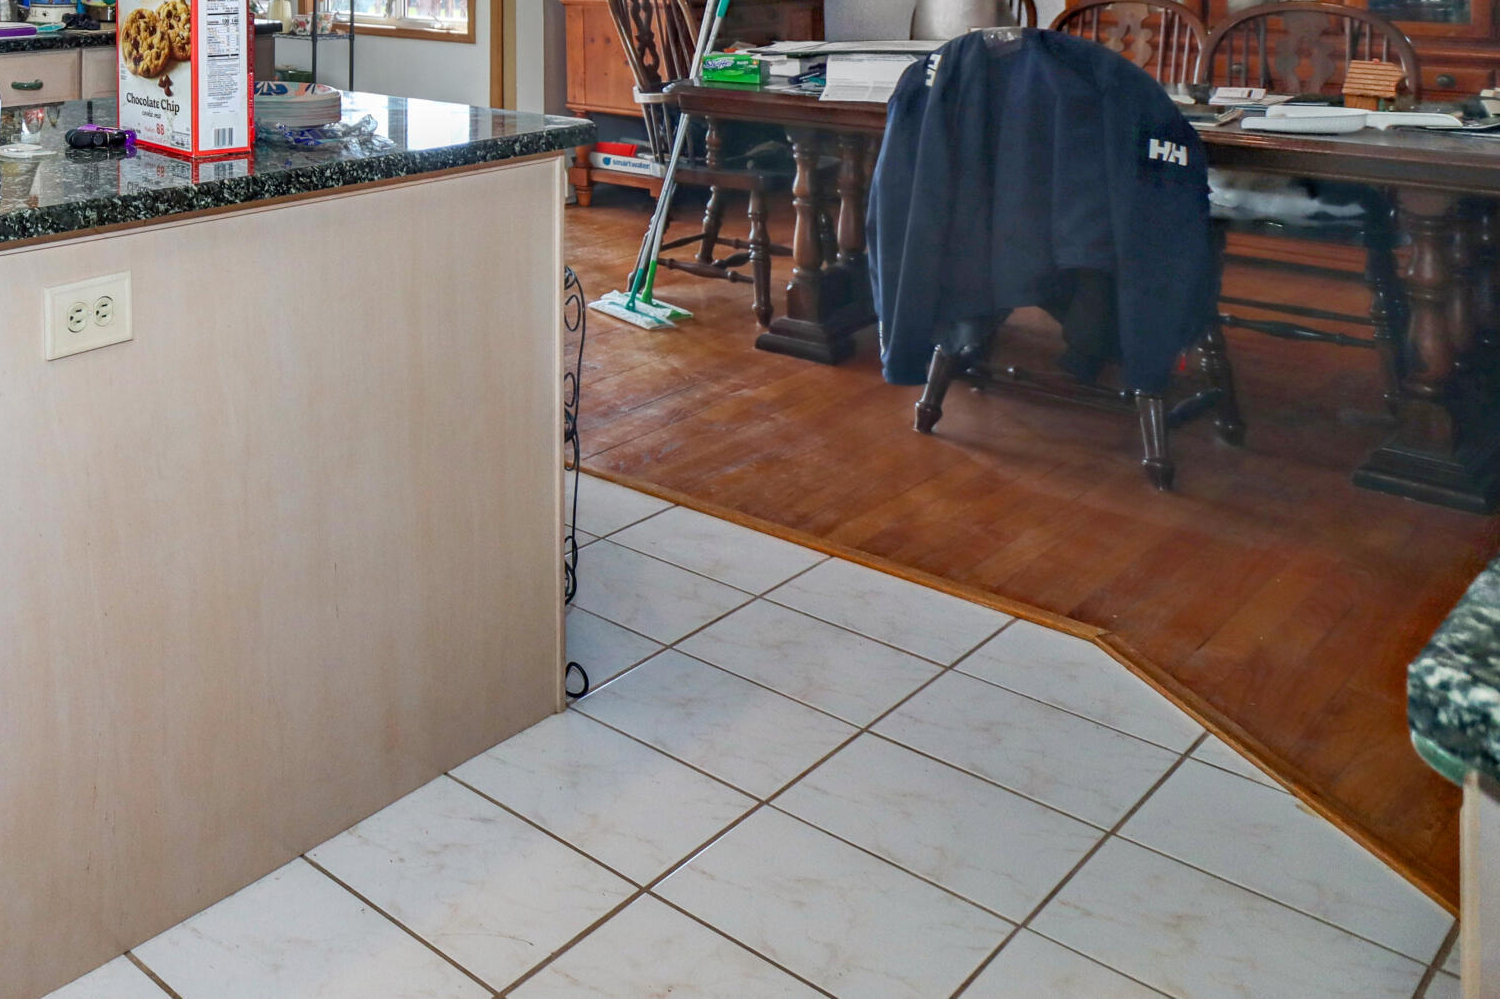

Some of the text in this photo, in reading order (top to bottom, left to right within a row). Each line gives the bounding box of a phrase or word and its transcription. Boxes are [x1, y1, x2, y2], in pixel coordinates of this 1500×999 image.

[126, 92, 180, 115] Chocolate Chip
[612, 158, 651, 170] smartwater
[1148, 138, 1189, 167] HH
